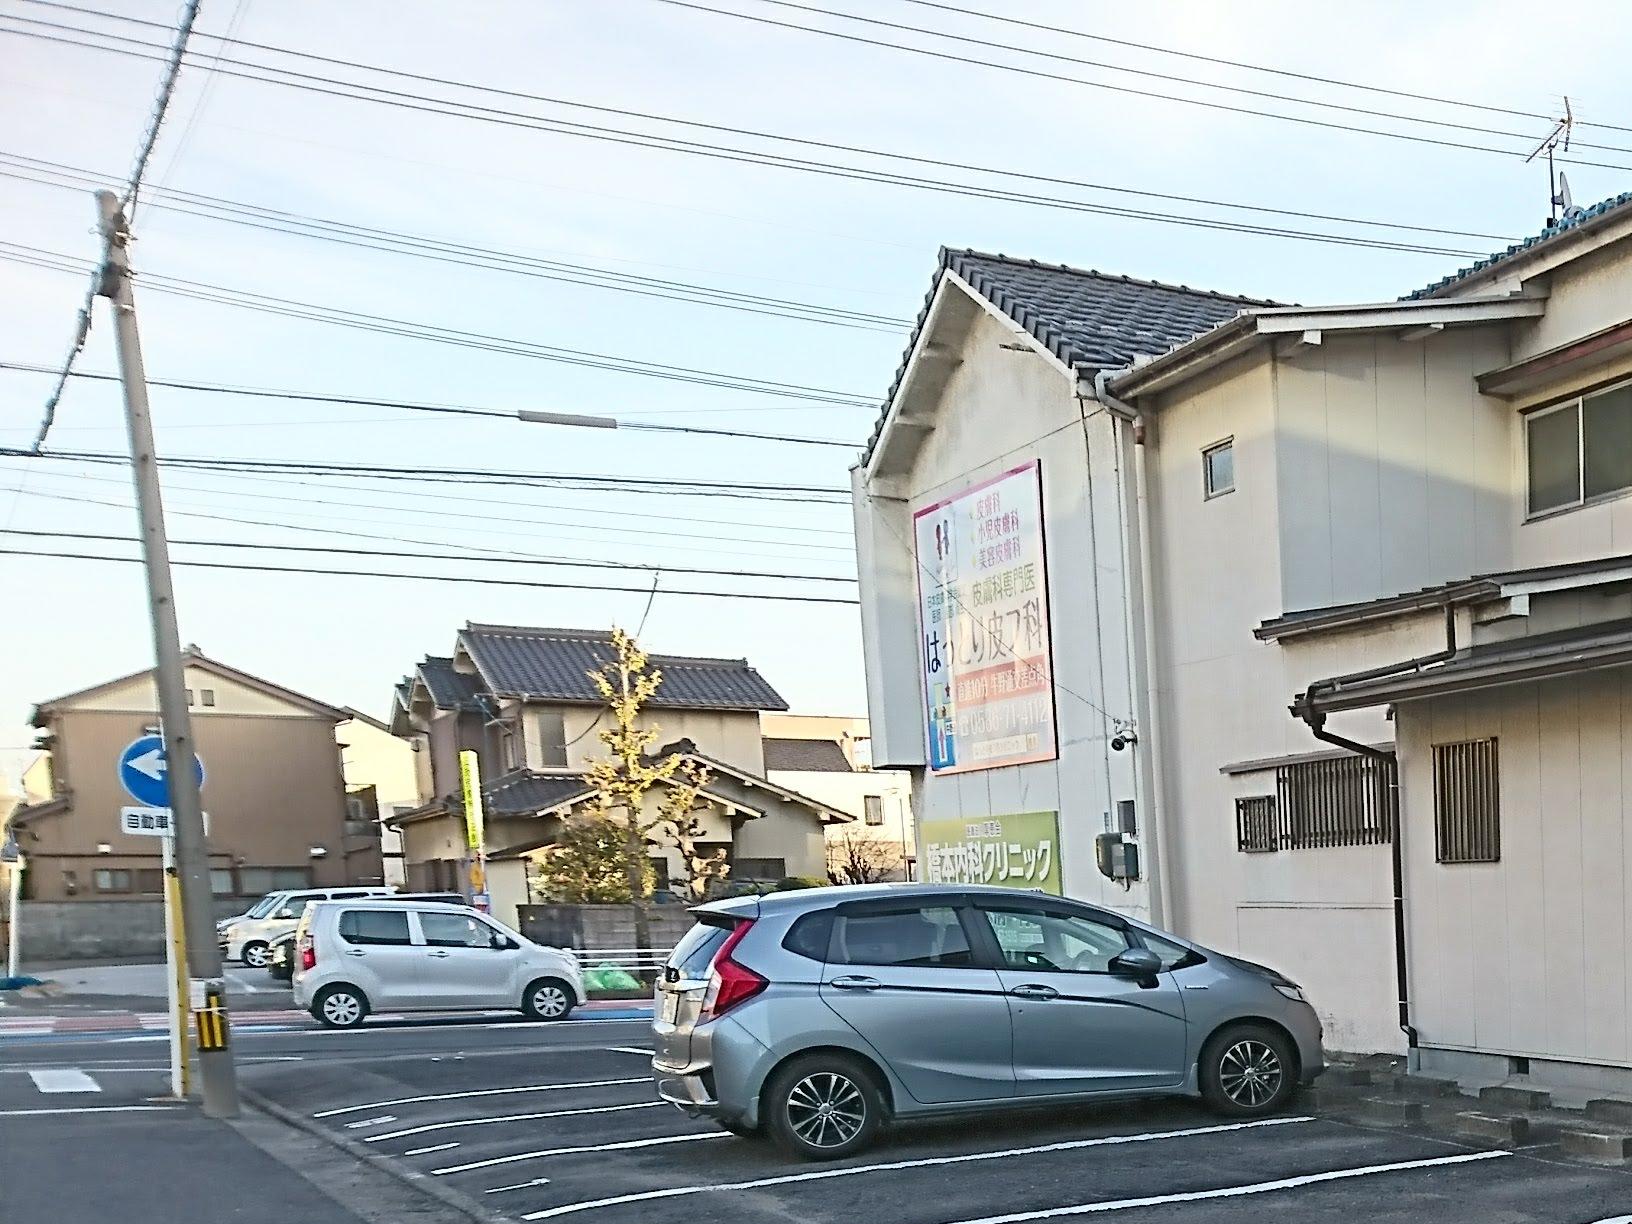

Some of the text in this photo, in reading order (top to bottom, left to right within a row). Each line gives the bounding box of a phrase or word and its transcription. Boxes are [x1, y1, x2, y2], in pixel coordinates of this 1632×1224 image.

[127, 813, 176, 830] 自動車
[927, 840, 1052, 884] 橋本内科クリニック
